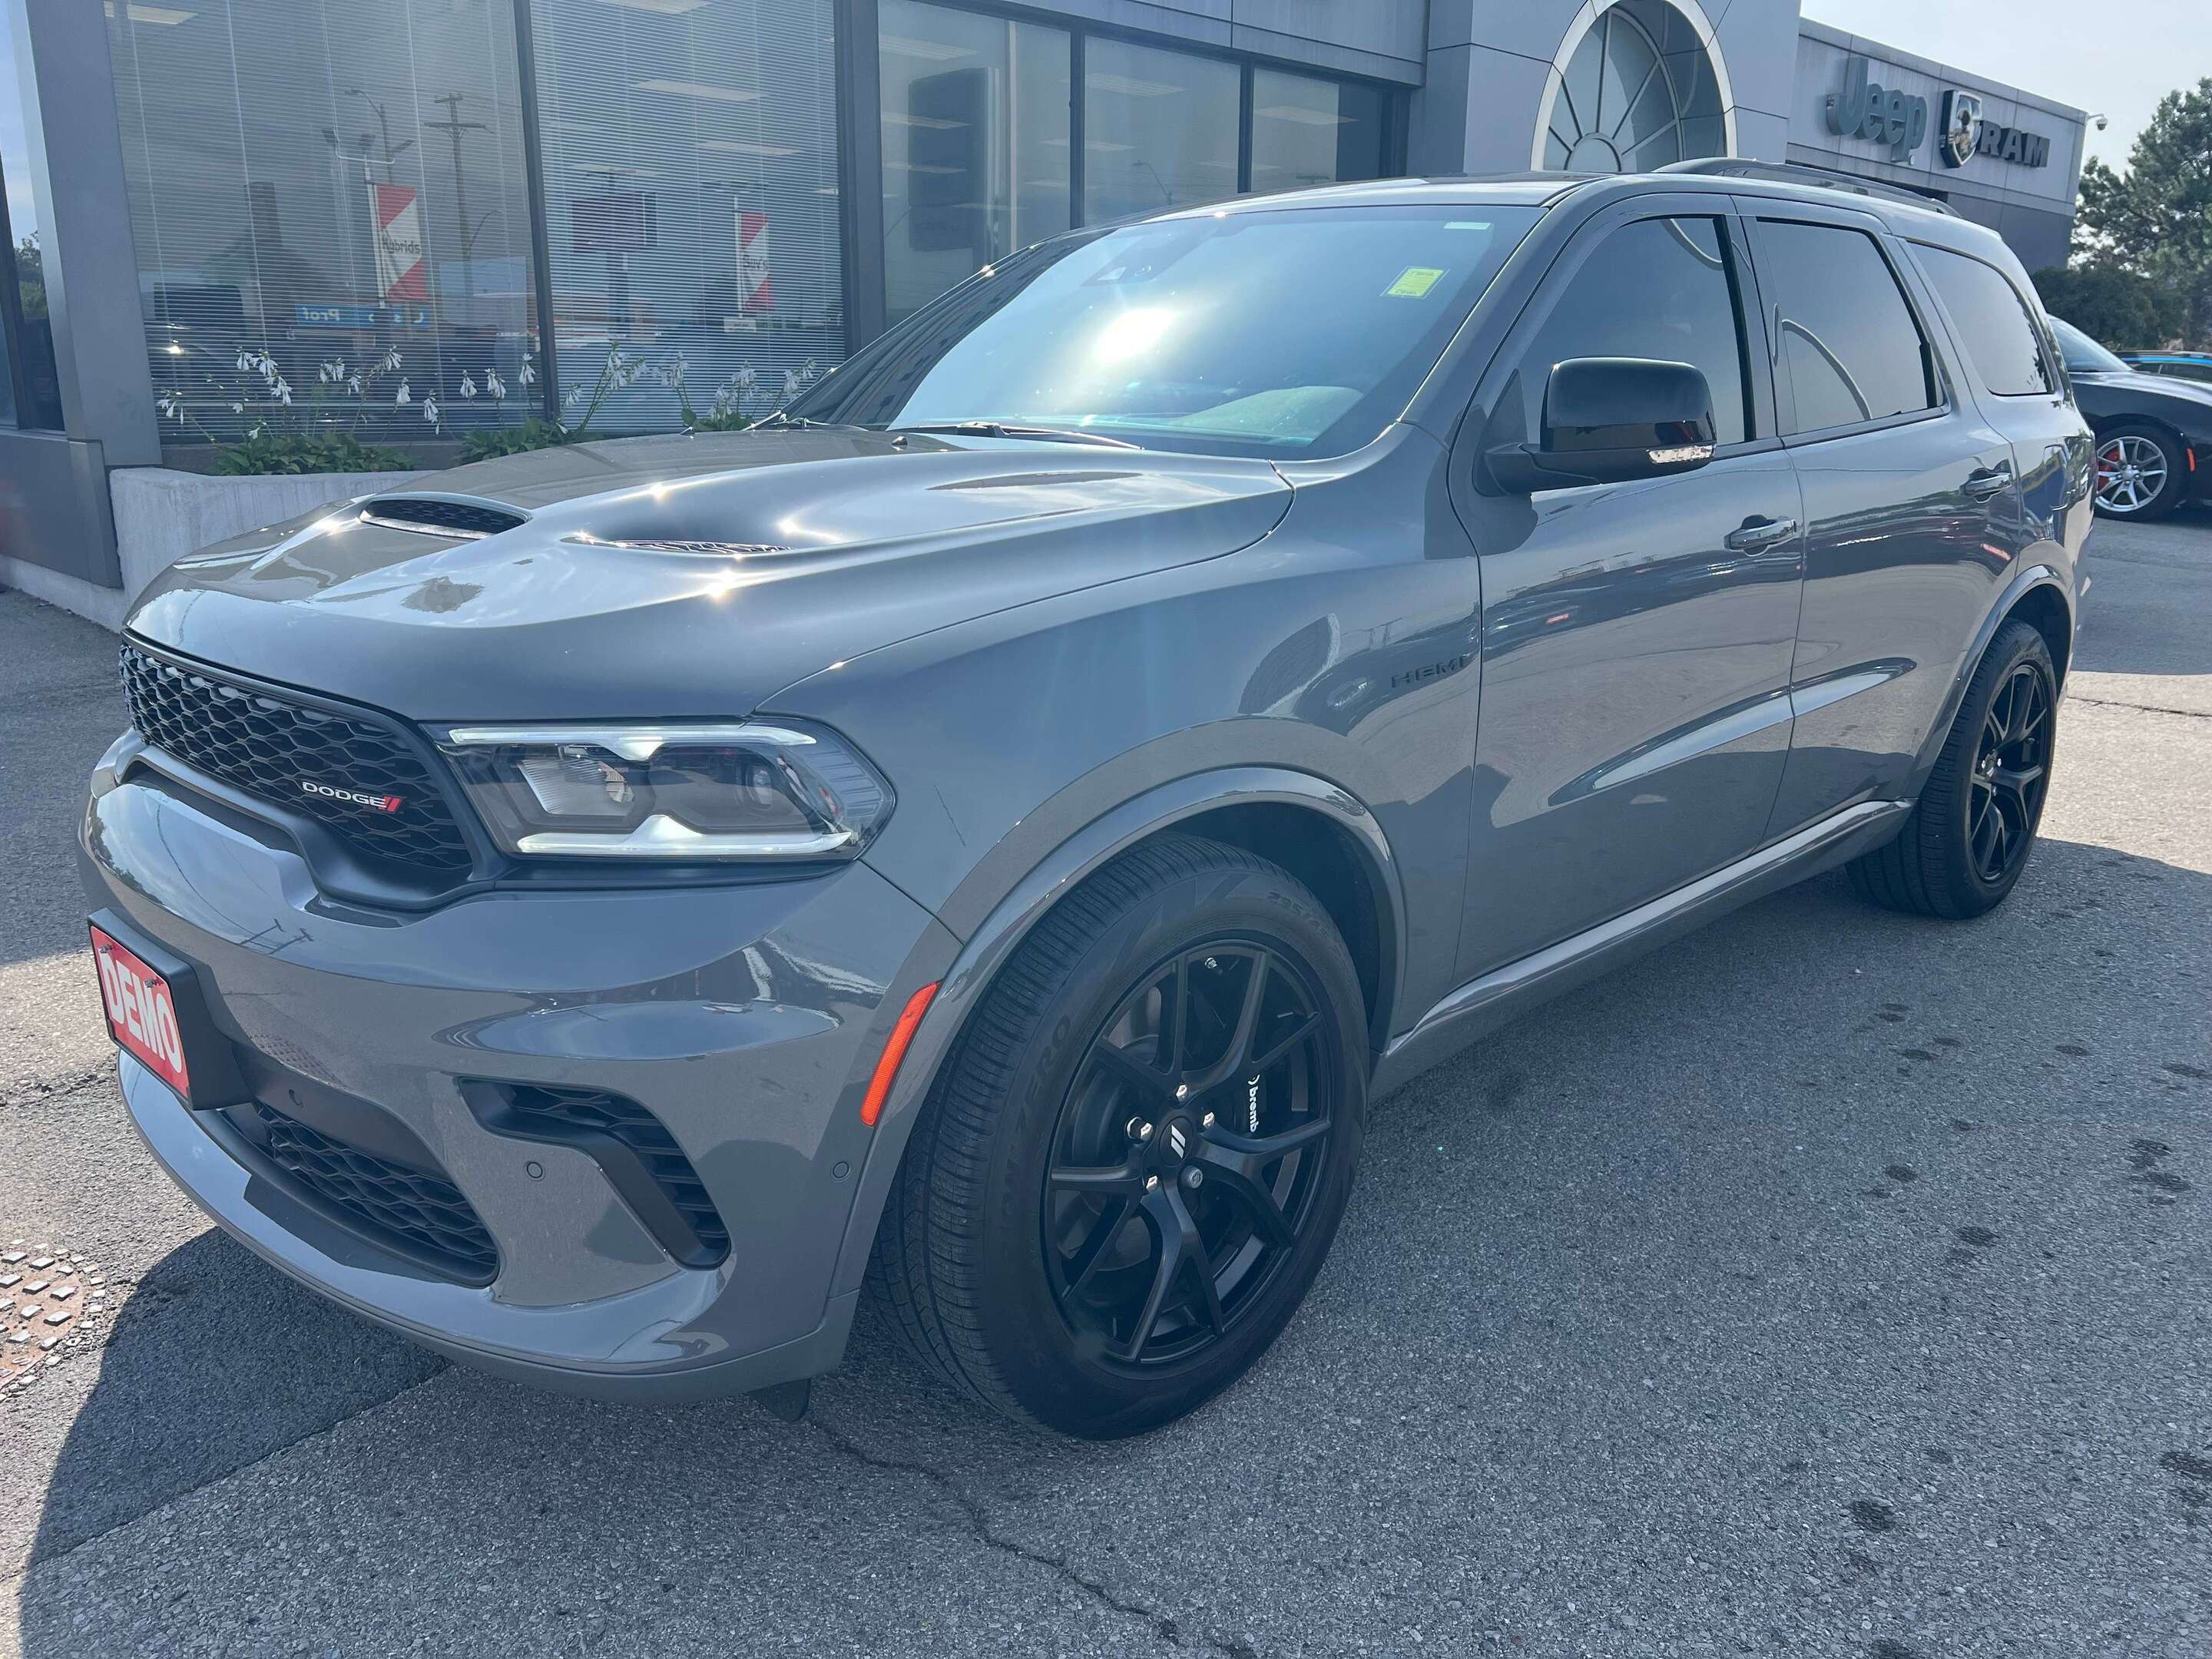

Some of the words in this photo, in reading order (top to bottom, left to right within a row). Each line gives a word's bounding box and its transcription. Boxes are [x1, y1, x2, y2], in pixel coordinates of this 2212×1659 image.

[1826, 57, 1929, 163] Jeep
[1978, 119, 2051, 167] RAM
[1391, 653, 1469, 689] HEMI
[302, 780, 387, 809] DODGE
[99, 952, 183, 1075] DEMO
